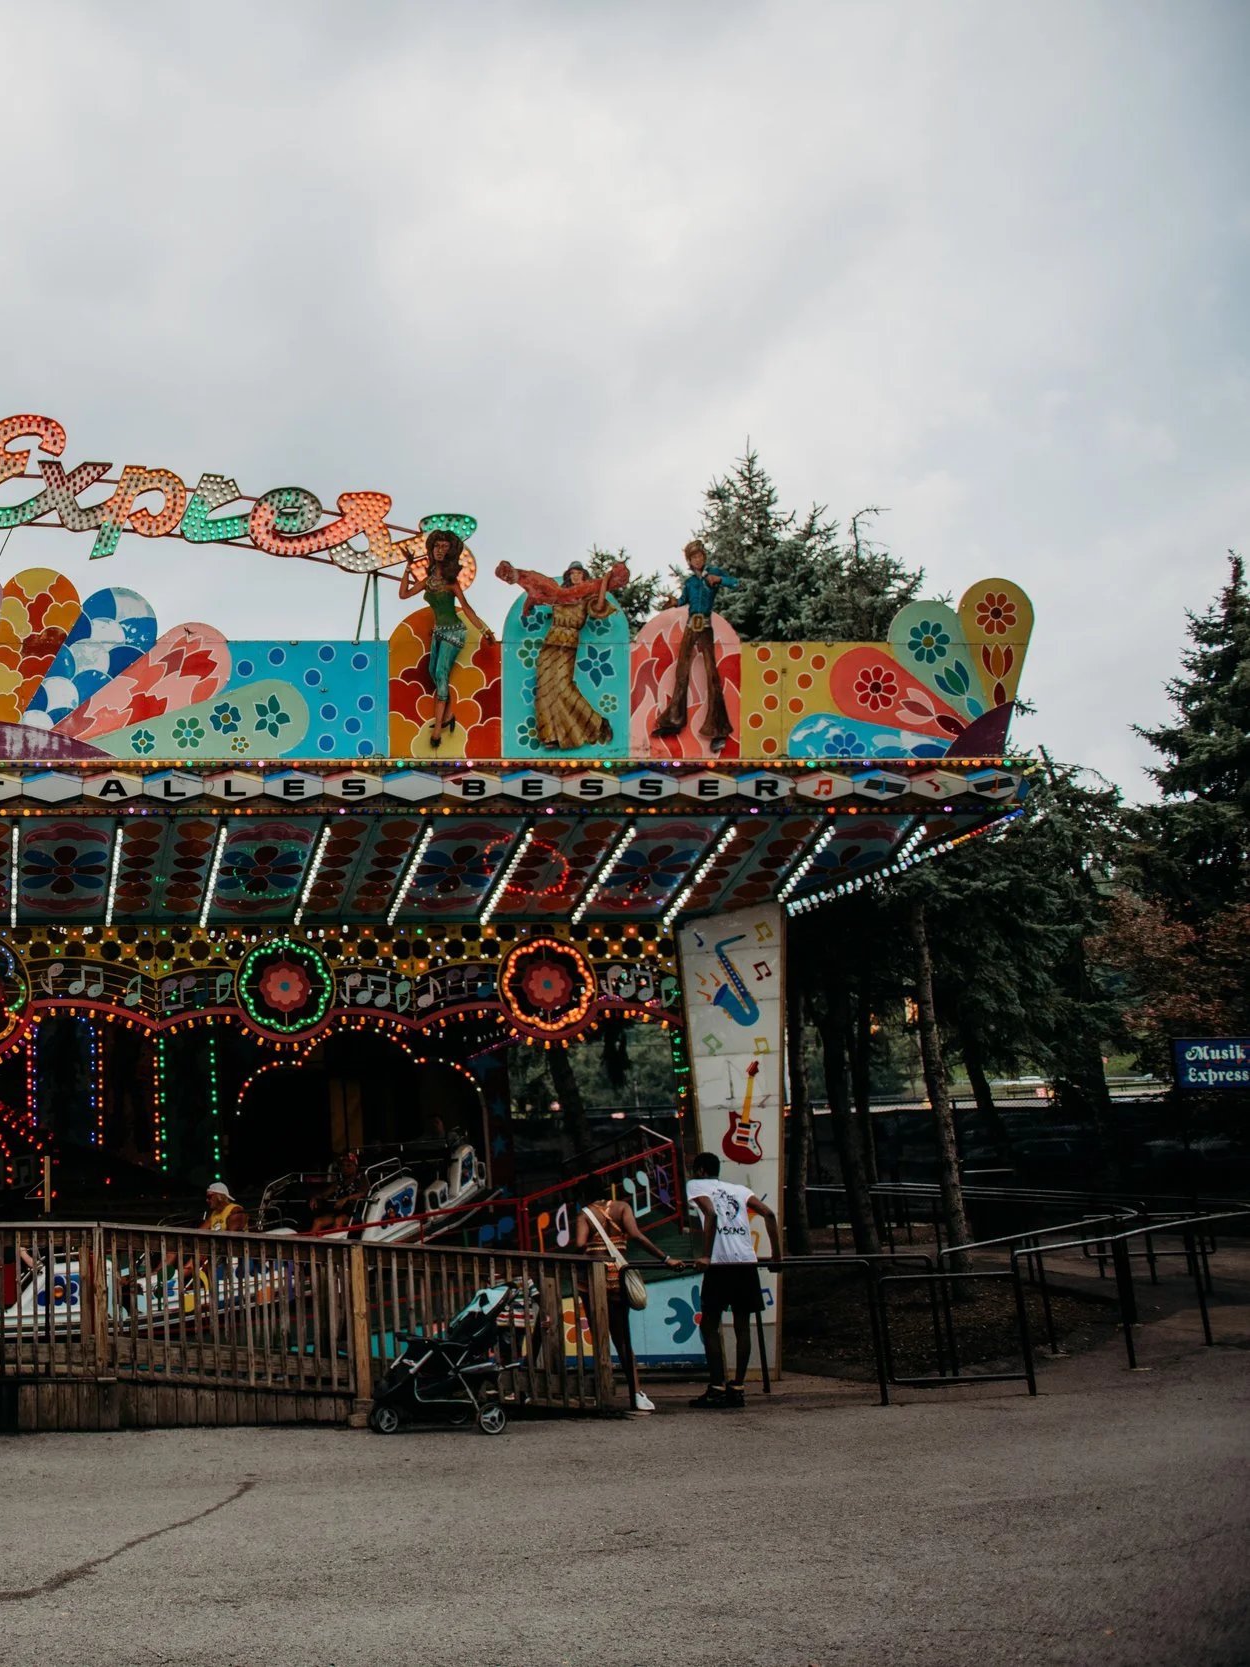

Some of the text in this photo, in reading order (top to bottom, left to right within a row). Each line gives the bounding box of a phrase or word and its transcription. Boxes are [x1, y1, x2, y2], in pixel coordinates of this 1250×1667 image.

[99, 778, 367, 798] ALLES
[461, 778, 780, 798] BESSER
[1185, 1044, 1247, 1061] Musik
[1187, 1067, 1250, 1085] Express
